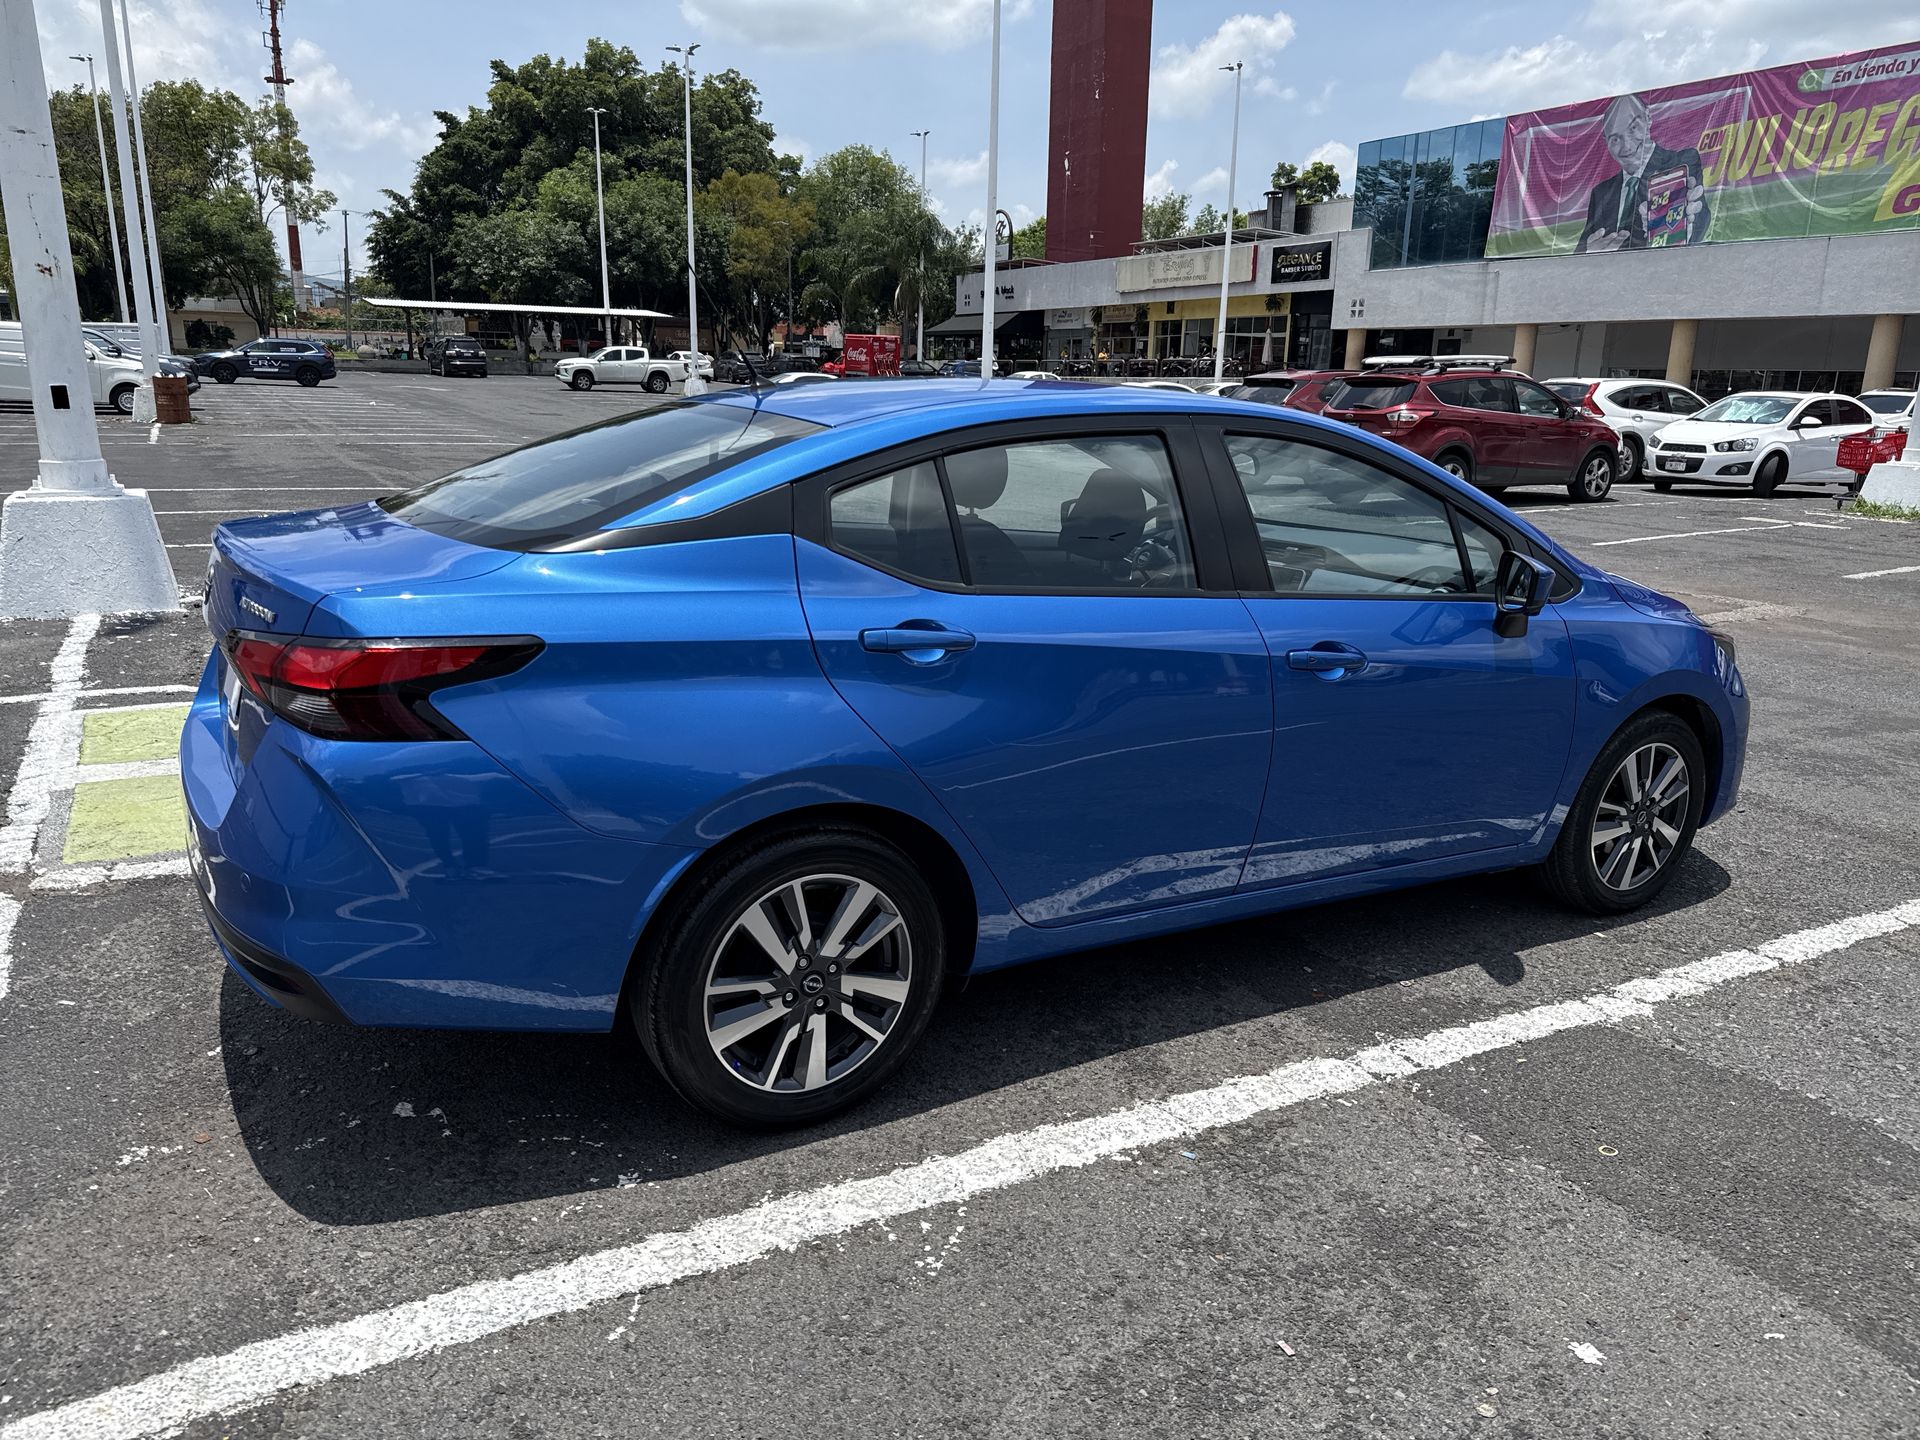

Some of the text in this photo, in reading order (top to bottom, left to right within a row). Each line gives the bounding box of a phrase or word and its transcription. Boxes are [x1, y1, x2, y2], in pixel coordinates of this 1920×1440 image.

[1831, 69, 1853, 83] En
[1855, 59, 1906, 79] tienda
[1701, 128, 1727, 150] CON
[1277, 252, 1323, 268] ELEGANCE
[1281, 264, 1322, 274] BARBER STUDIO
